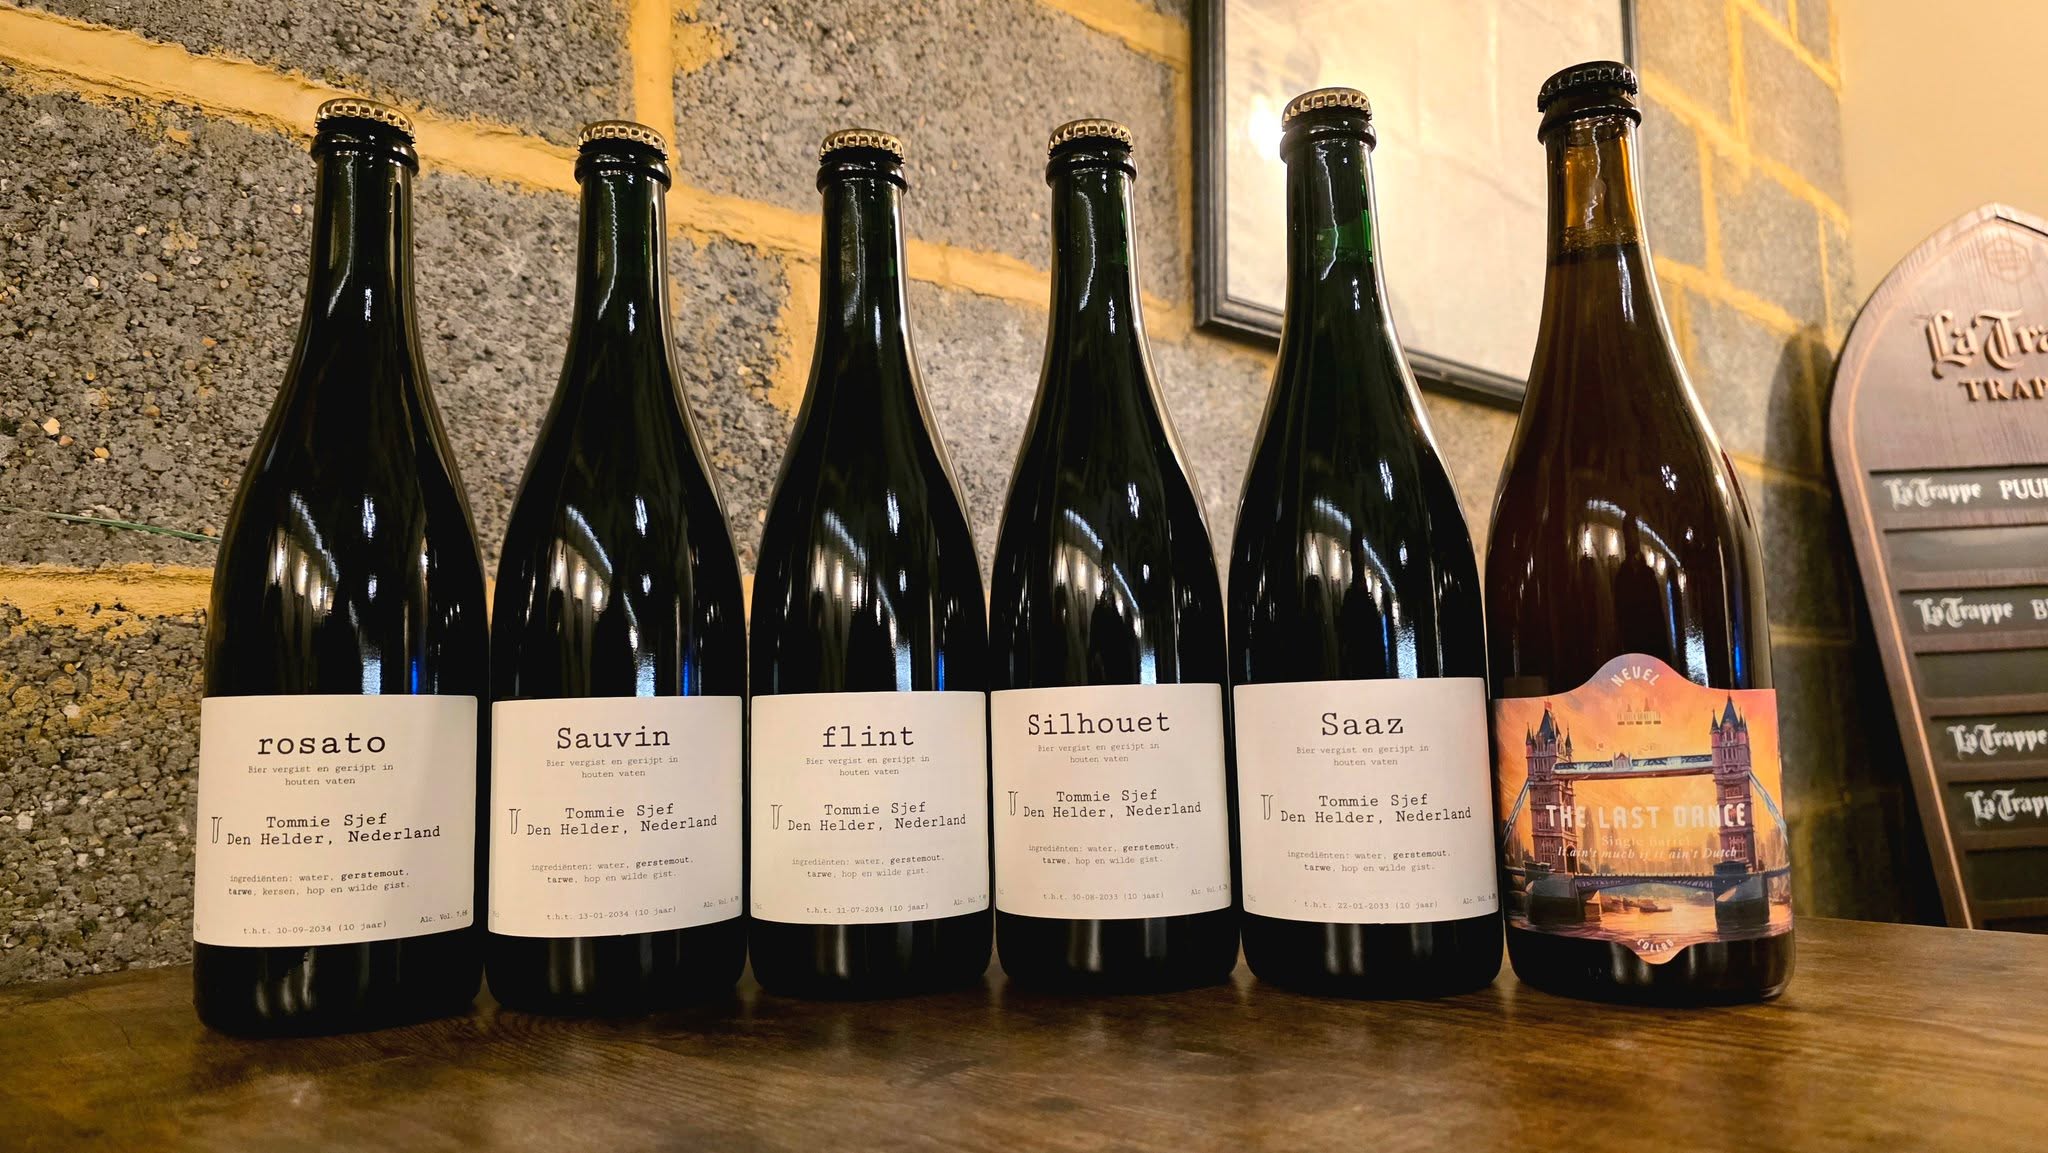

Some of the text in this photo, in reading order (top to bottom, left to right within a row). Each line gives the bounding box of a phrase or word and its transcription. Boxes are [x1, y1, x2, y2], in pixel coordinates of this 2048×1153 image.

[1910, 477, 1982, 507] Trappe
[1941, 596, 2013, 628] Trappe
[1028, 711, 1170, 737] Silhouet
[1321, 712, 1404, 736] Saaz
[257, 732, 386, 755] rosato
[556, 725, 671, 750] Sauvin
[822, 725, 915, 748] flint
[1037, 744, 1054, 753] Bier
[1058, 744, 1091, 753] vergist
[1110, 743, 1145, 753] gerijpt
[1296, 746, 1316, 754] Bier
[1320, 746, 1357, 755] vergist
[1378, 745, 1415, 755] gerijpt
[546, 759, 565, 767] Bier
[569, 758, 606, 768] vergist
[611, 758, 623, 766] en
[627, 756, 663, 767] gerijpt
[805, 757, 823, 765] Bier
[828, 756, 862, 766] vergist
[882, 755, 916, 766] gerijpt
[1070, 755, 1129, 763] houten vaten
[1333, 758, 1398, 766] houten vaten
[248, 762, 394, 775] Bier vergist en gerijpt in
[581, 769, 646, 779] houten vaten
[839, 768, 870, 776] houten
[285, 776, 356, 786] houten vaten
[1056, 789, 1158, 803] Tommie Sjef
[1318, 794, 1429, 808] Tommie Sjef
[565, 803, 674, 819] Tommie Sjef
[824, 802, 926, 816] Tommie Sjef
[1023, 802, 1202, 819] Den Helder, Nederland
[1280, 806, 1472, 824] Den Helder, Nederland
[1545, 803, 1746, 829] THE LAST DANCE
[266, 813, 388, 829] Tommie Sjef
[527, 815, 718, 836] Den Helder, Nederland
[787, 814, 966, 831] Den Helder, Nederland
[227, 826, 441, 846] Den Helder, Nederland
[1704, 847, 1737, 859] Dutch
[1075, 857, 1091, 866] hop
[1109, 856, 1135, 864] wilde
[1341, 864, 1358, 873] hop
[1378, 863, 1406, 871] wilde
[583, 875, 600, 884] hop
[621, 872, 648, 881] wilde
[841, 870, 857, 879] hop
[876, 868, 902, 876] wilde
[306, 885, 325, 896] hop
[330, 885, 343, 894] en
[347, 882, 378, 892] wilde
[276, 924, 331, 934] 10-09-2034
[1636, 938, 1674, 953] COLLAB
